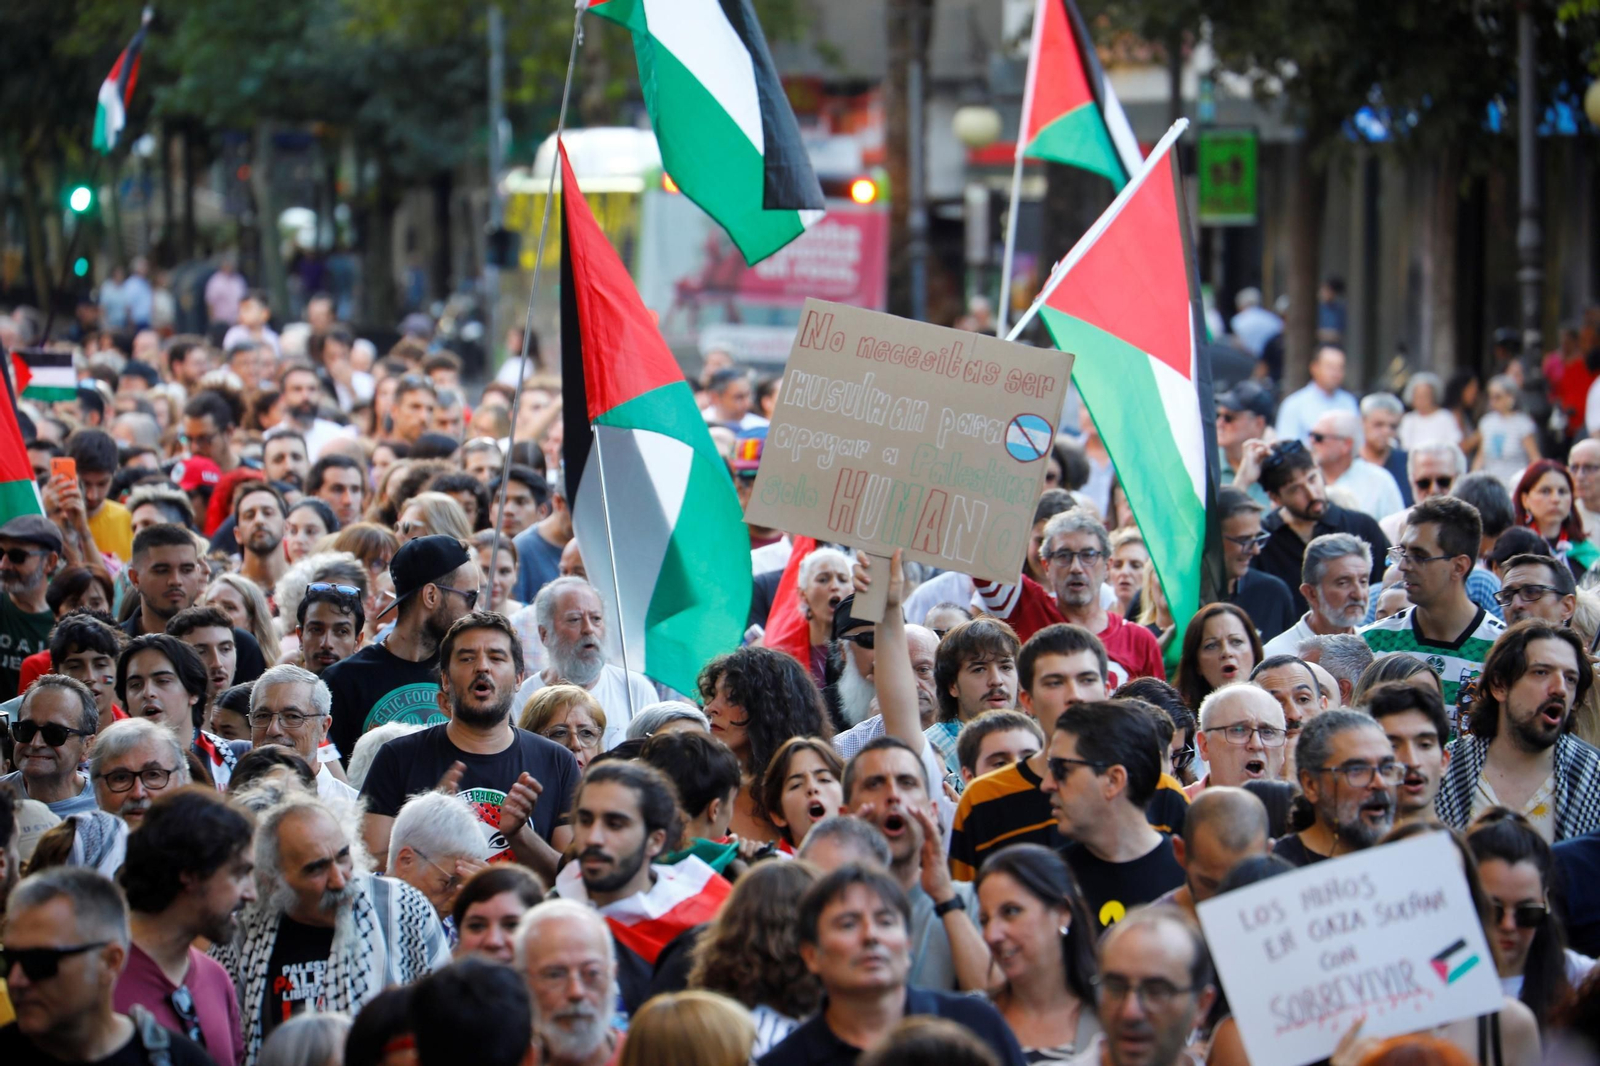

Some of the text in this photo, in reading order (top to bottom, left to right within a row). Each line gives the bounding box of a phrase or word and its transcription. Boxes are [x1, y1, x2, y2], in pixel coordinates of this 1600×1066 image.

[800, 310, 845, 353] No
[856, 336, 1001, 386] necesitas
[1004, 368, 1055, 398] ser
[936, 408, 1005, 450] para
[774, 423, 1041, 510] apoyar a Palestina
[827, 467, 1023, 573] HUMANO
[1238, 899, 1287, 932] LOS
[1262, 928, 1297, 962] EN
[1306, 909, 1367, 942] GAZA
[1269, 959, 1421, 1027] SOBREVIVIR
